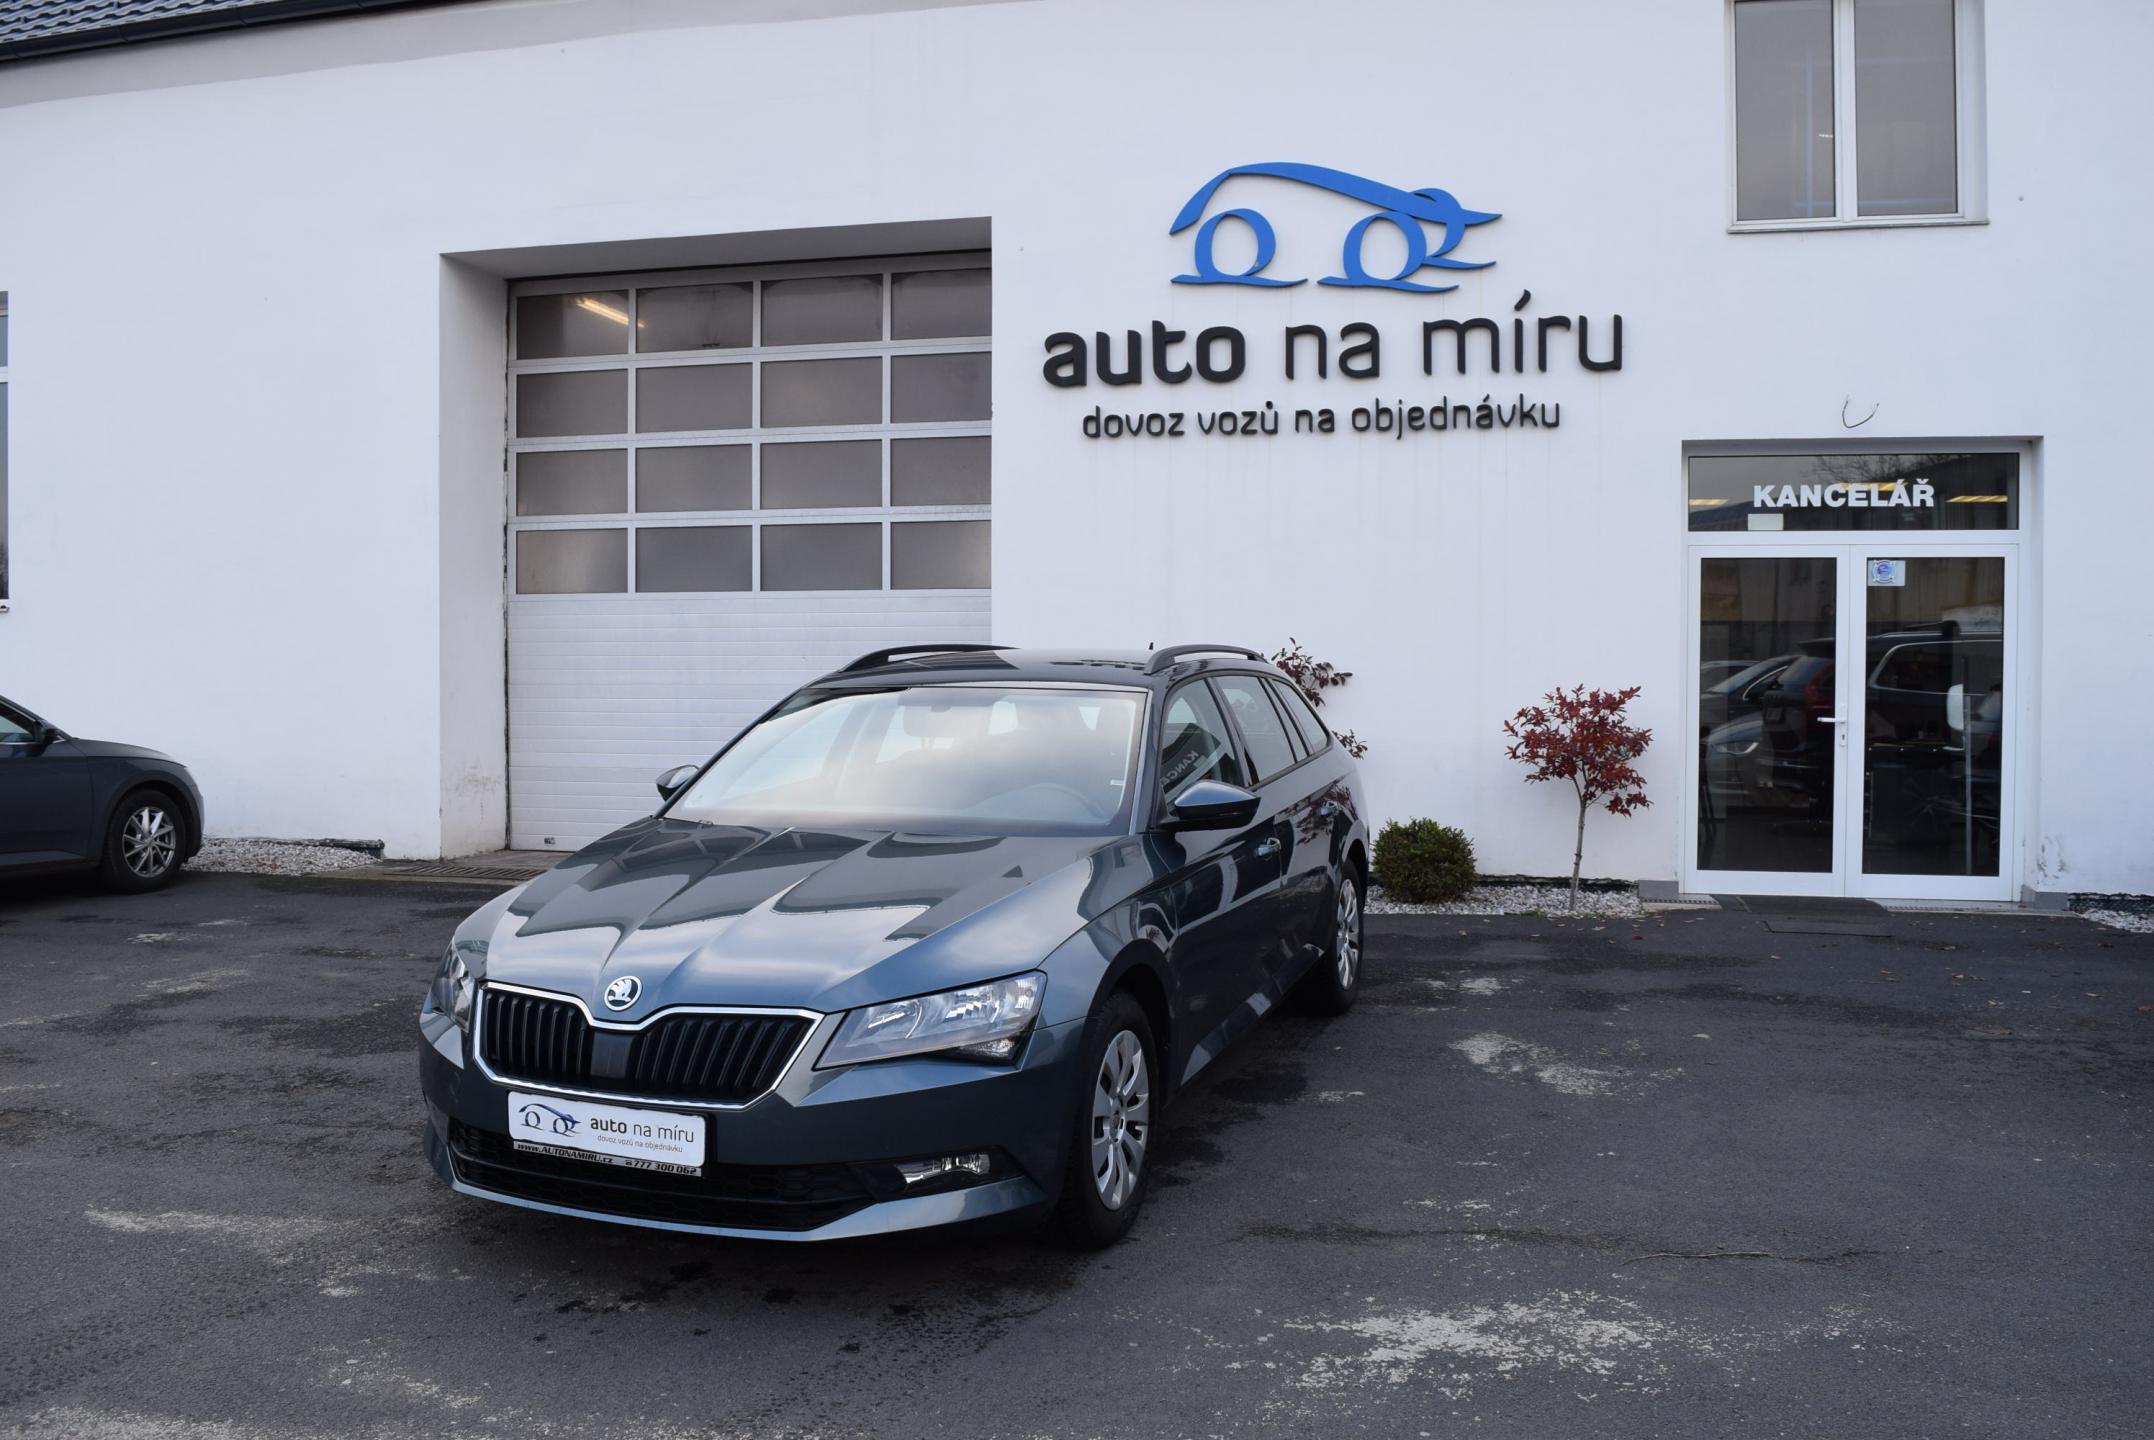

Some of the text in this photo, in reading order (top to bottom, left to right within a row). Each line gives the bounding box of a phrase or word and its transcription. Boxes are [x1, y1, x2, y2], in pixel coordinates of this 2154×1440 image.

[1043, 289, 1623, 388] auto na míru
[1082, 393, 1561, 440] dovoz vozů na objednávku
[1753, 478, 1935, 508] KANCELÁŘ
[590, 1117, 694, 1143] auto na míru
[597, 1134, 683, 1153] dovoz vozů na objednávku
[634, 1160, 652, 1169] 777
[655, 1163, 674, 1173] 300
